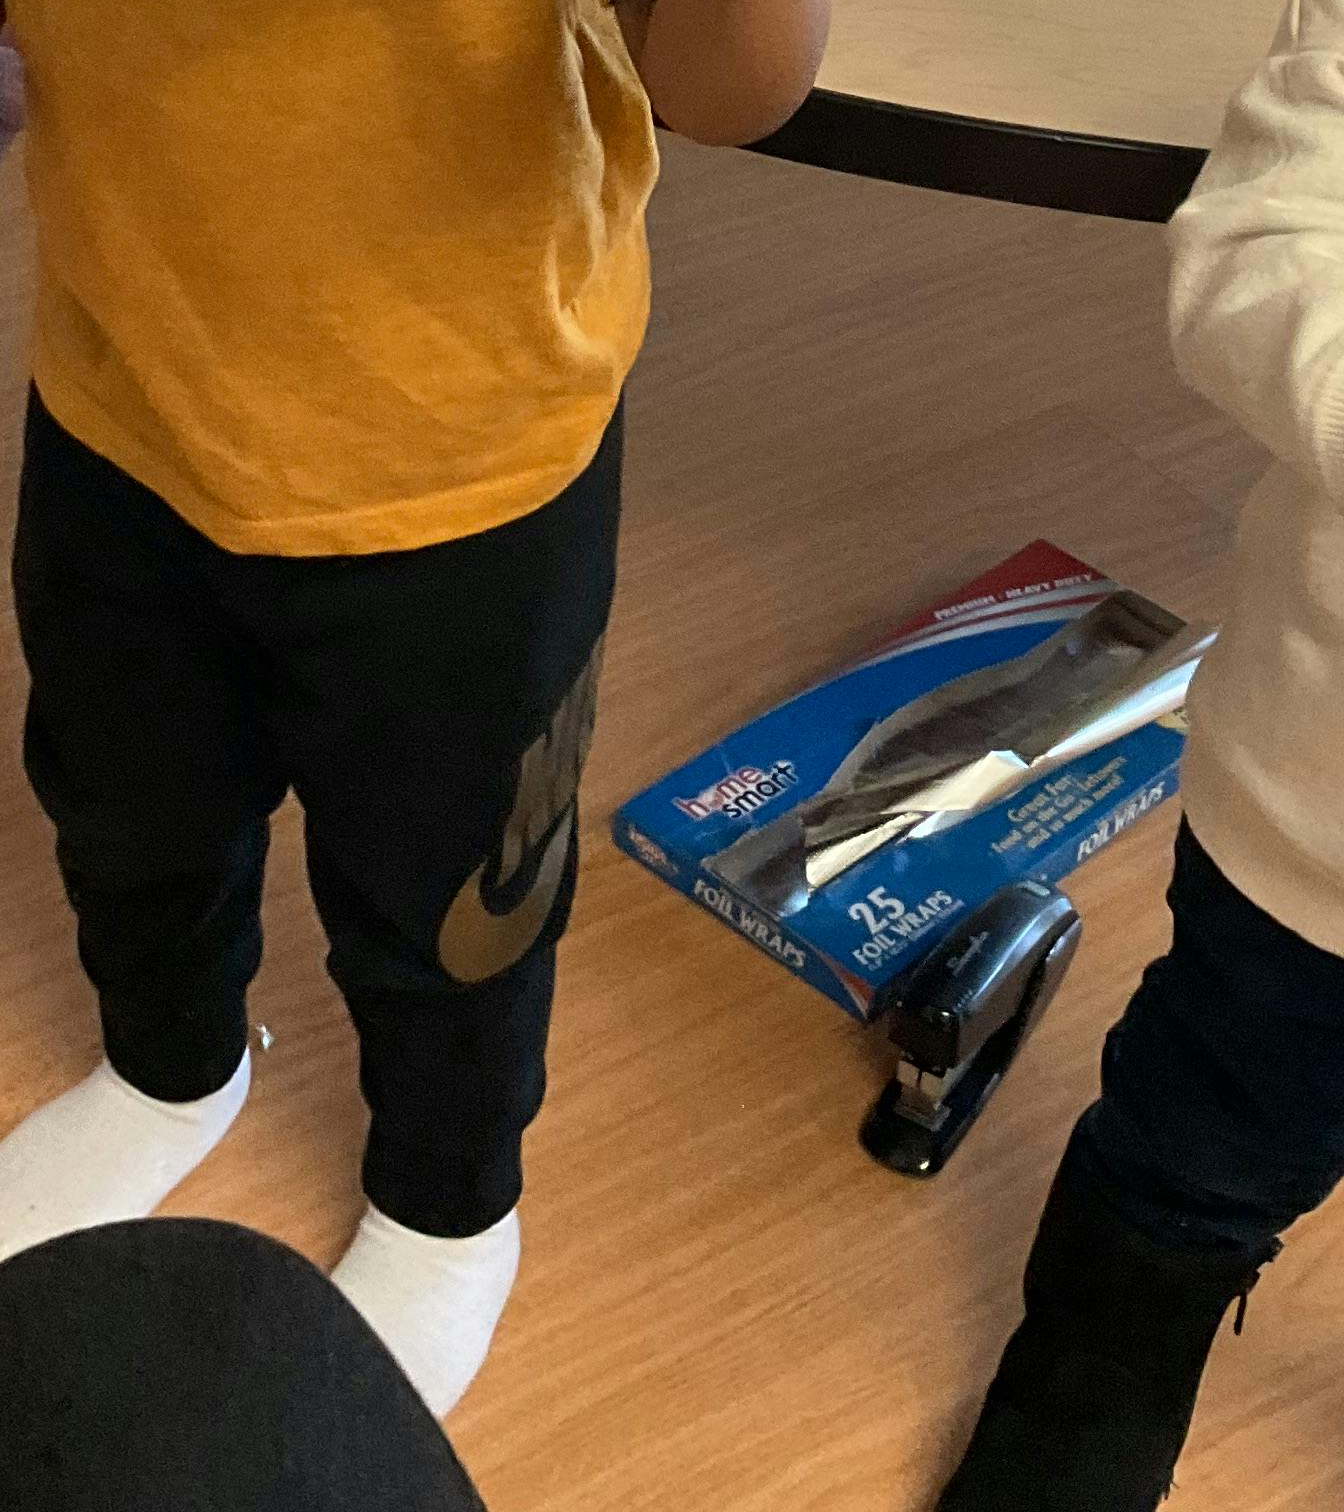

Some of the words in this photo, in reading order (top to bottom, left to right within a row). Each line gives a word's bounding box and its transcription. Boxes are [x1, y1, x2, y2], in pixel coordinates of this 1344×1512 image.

[722, 761, 798, 819] smart
[1076, 819, 1111, 862] FOIL
[1113, 781, 1167, 835] WRAPS
[694, 879, 733, 920] FOIL
[739, 904, 807, 968] WRAPS
[848, 886, 905, 934] 25
[852, 934, 896, 965] FOIL
[889, 890, 953, 938] WRAPS
